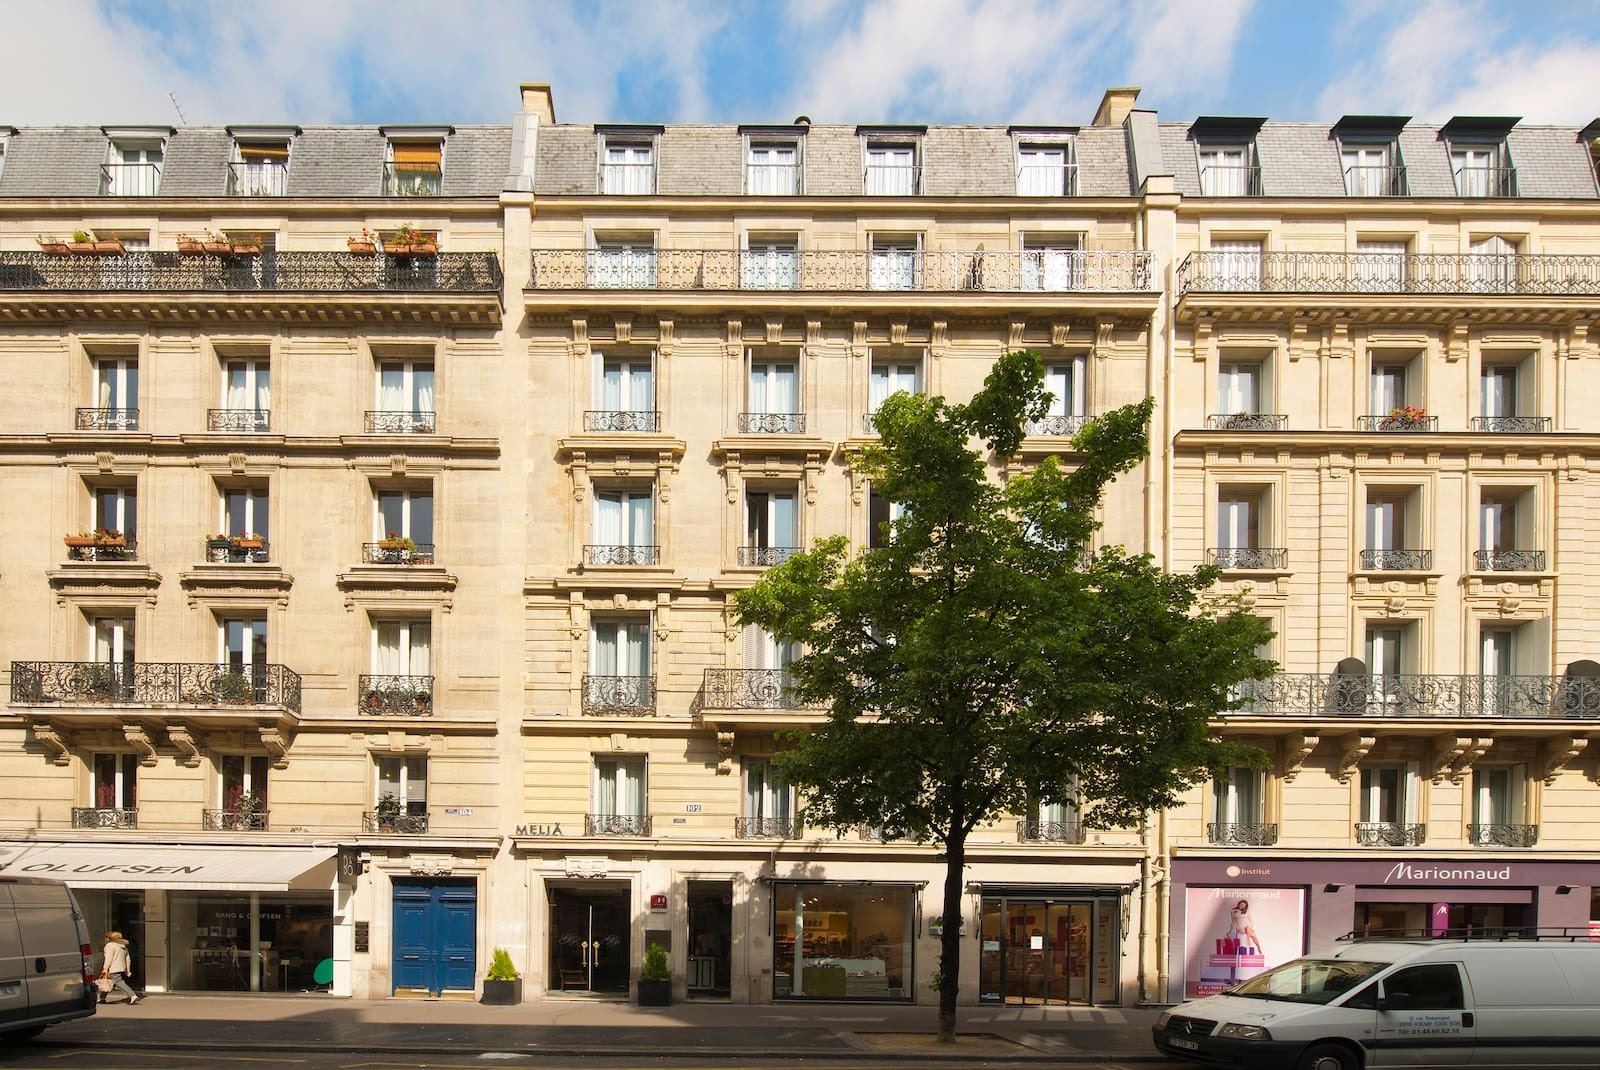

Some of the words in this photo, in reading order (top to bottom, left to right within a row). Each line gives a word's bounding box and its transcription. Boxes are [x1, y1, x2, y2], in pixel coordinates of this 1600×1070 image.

[687, 804, 701, 812] 102
[21, 863, 204, 874] OLUFSEN
[1384, 862, 1510, 883] Marionnaud
[1208, 888, 1280, 900] Marionnaud
